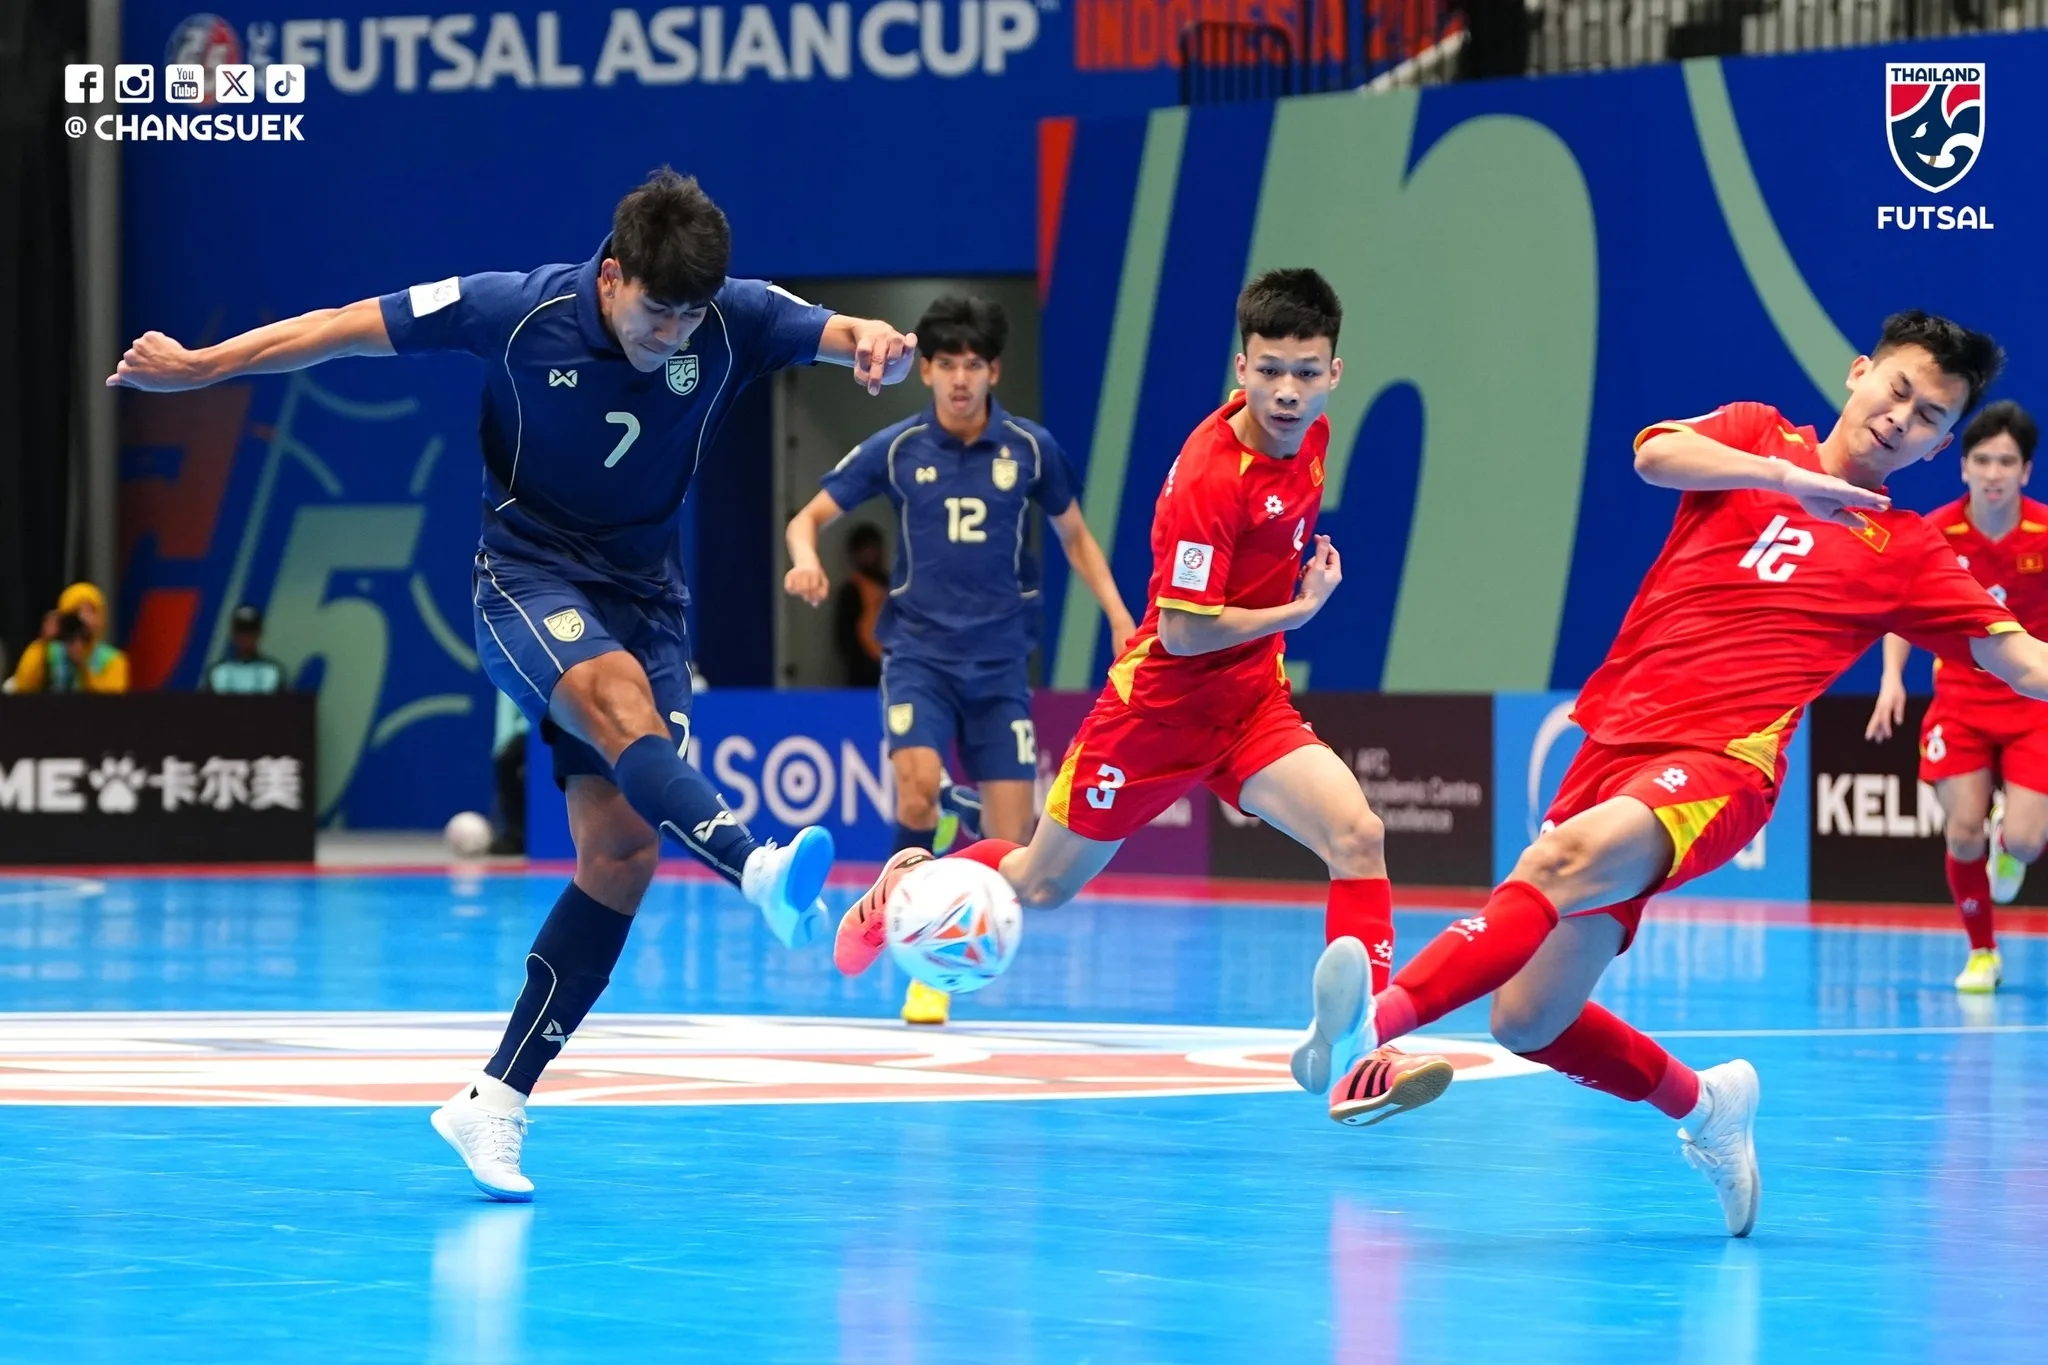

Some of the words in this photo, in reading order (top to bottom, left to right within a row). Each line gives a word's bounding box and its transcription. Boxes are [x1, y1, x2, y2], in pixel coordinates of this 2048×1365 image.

[281, 11, 584, 93] FUTSAL
[593, 3, 852, 85] ASIAN
[859, 0, 1039, 77] CUP
[605, 411, 640, 468] 7
[944, 497, 987, 543] 12
[1738, 514, 1815, 582] 12
[148, 754, 303, 812] 卡尔美
[1086, 763, 1126, 810] 3
[1817, 773, 1990, 837] KELM
